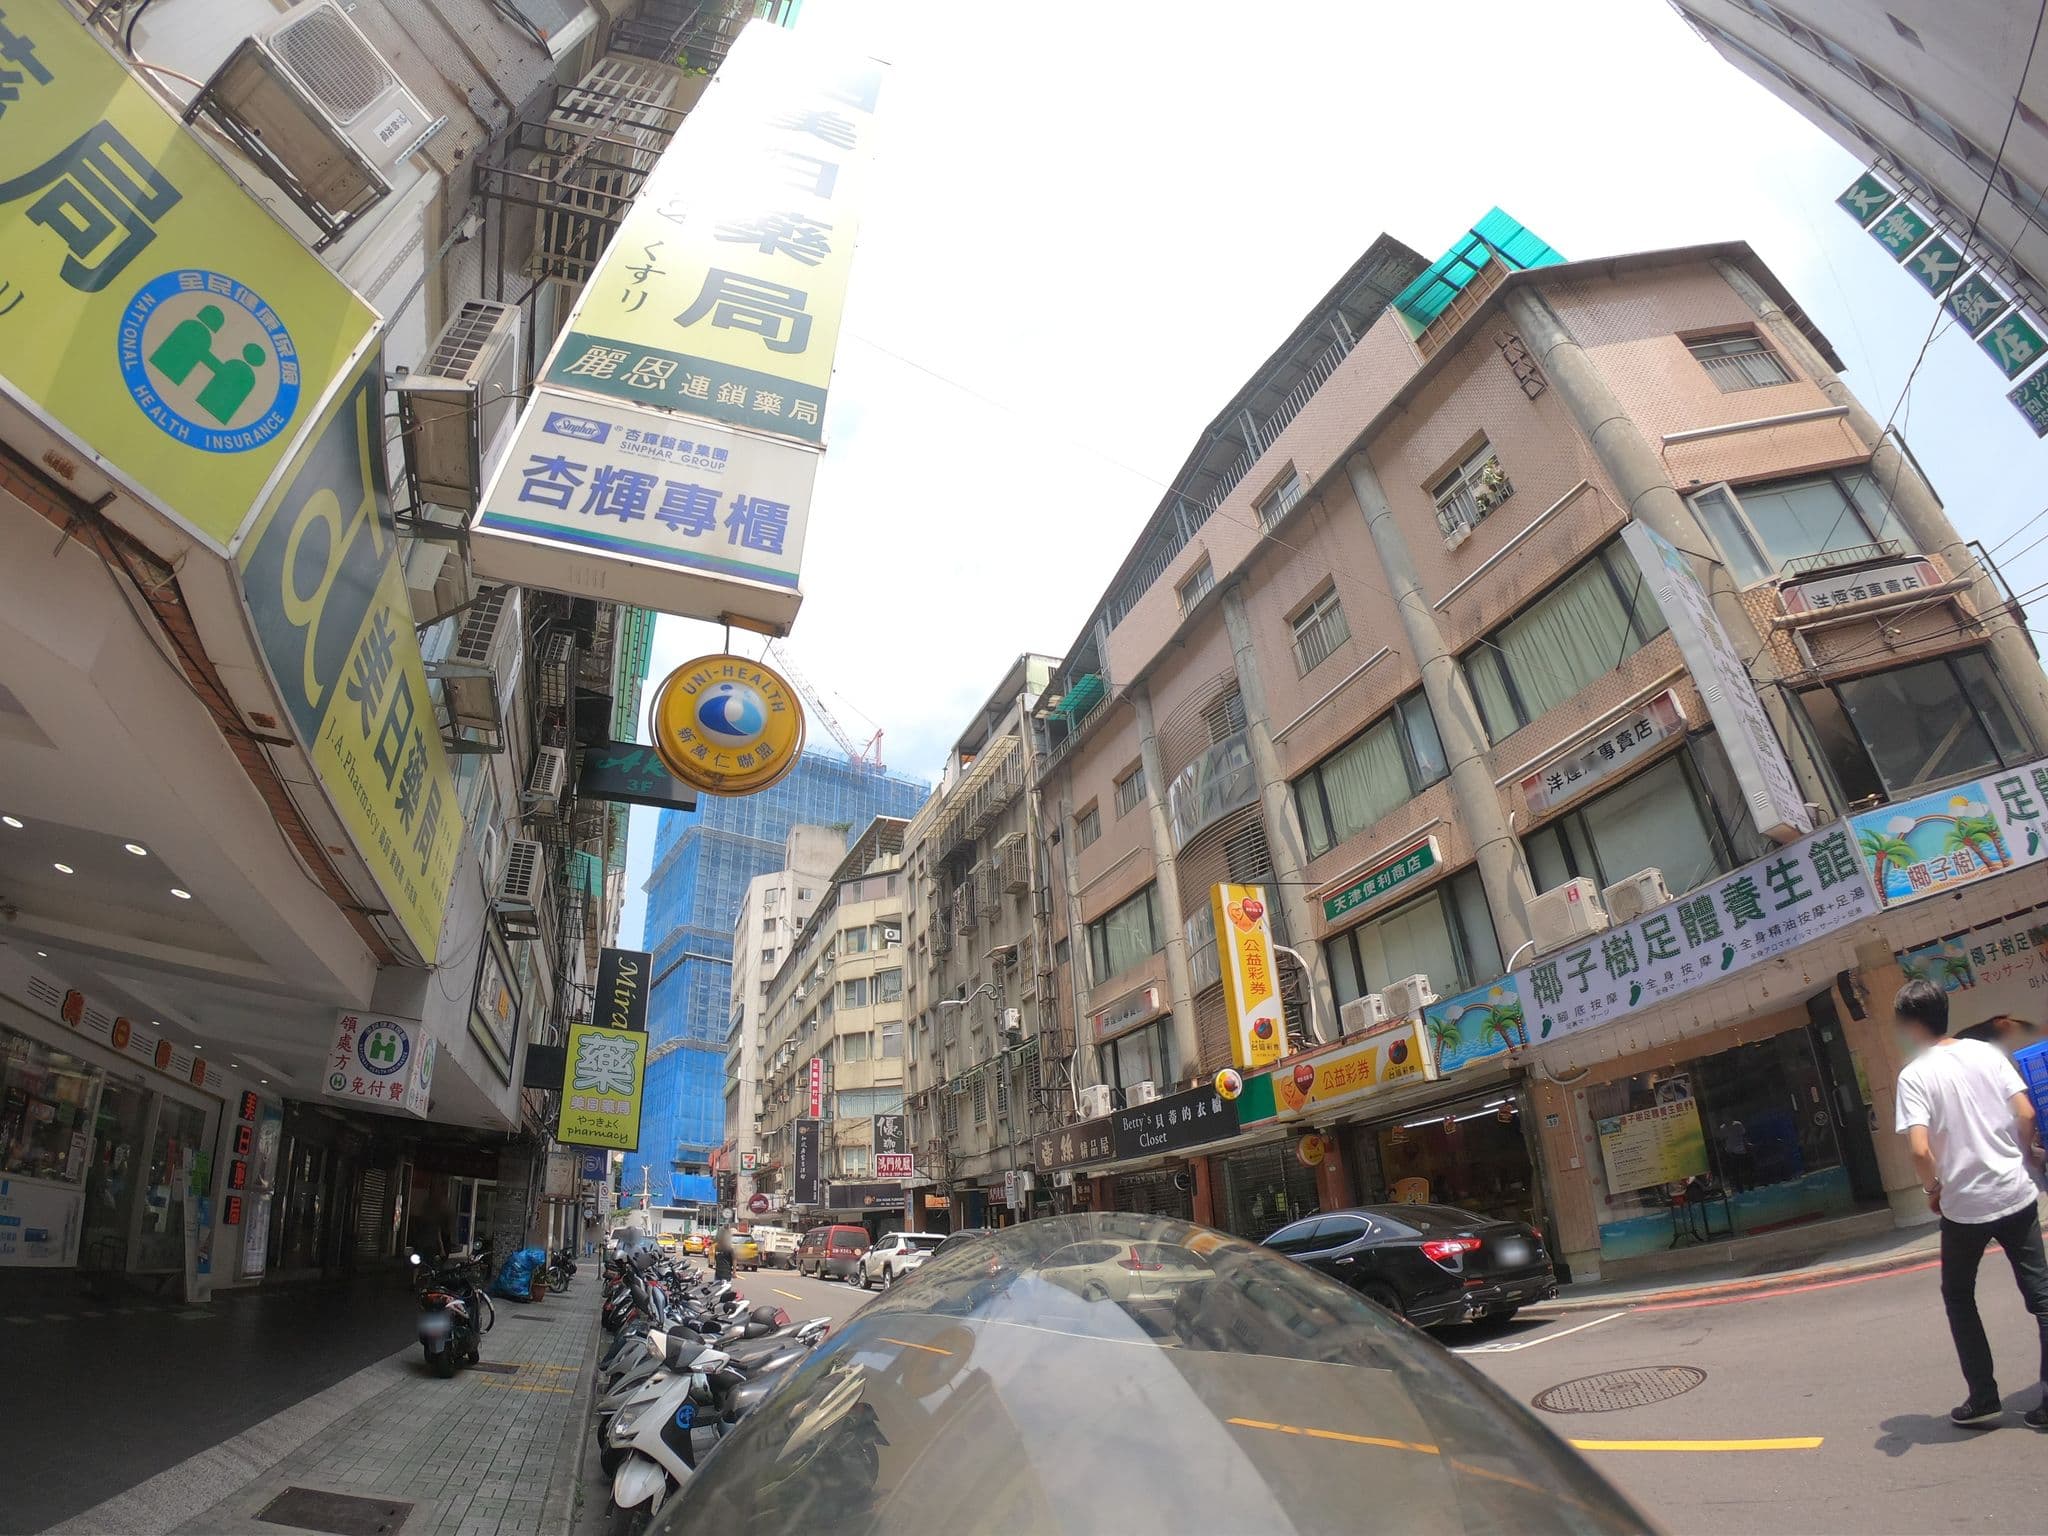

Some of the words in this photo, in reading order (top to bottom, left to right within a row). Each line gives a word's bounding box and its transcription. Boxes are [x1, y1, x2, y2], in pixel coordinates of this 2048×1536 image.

[123, 292, 157, 371] NATIONAL
[562, 344, 819, 426] 麗恩連鎖藥局
[134, 384, 190, 440] HEALTH
[204, 411, 285, 450] INSURANCE
[558, 419, 598, 437] Sinphar
[619, 441, 674, 460] SINPHAR
[681, 455, 726, 471] GROUP
[517, 454, 792, 556] 杏輝專櫃
[682, 664, 786, 714] UNI-HEALTH
[346, 605, 443, 877] 美日藥局
[1334, 854, 1422, 914] 天津便利商店
[1907, 849, 1976, 890] 椰子樹
[1529, 827, 1861, 1011] 椰子樹足體養生館
[1243, 938, 1267, 995] 公益彩券
[1645, 953, 1713, 991] 全身按摩
[333, 1014, 359, 1072] 領處方
[571, 1031, 639, 1096] 藥
[350, 1076, 404, 1102] 免付費
[1322, 1057, 1371, 1091] 公益彩券
[569, 1094, 632, 1116] 美日藥局
[566, 1125, 630, 1145] pharmacy
[1139, 1131, 1168, 1148] Closet
